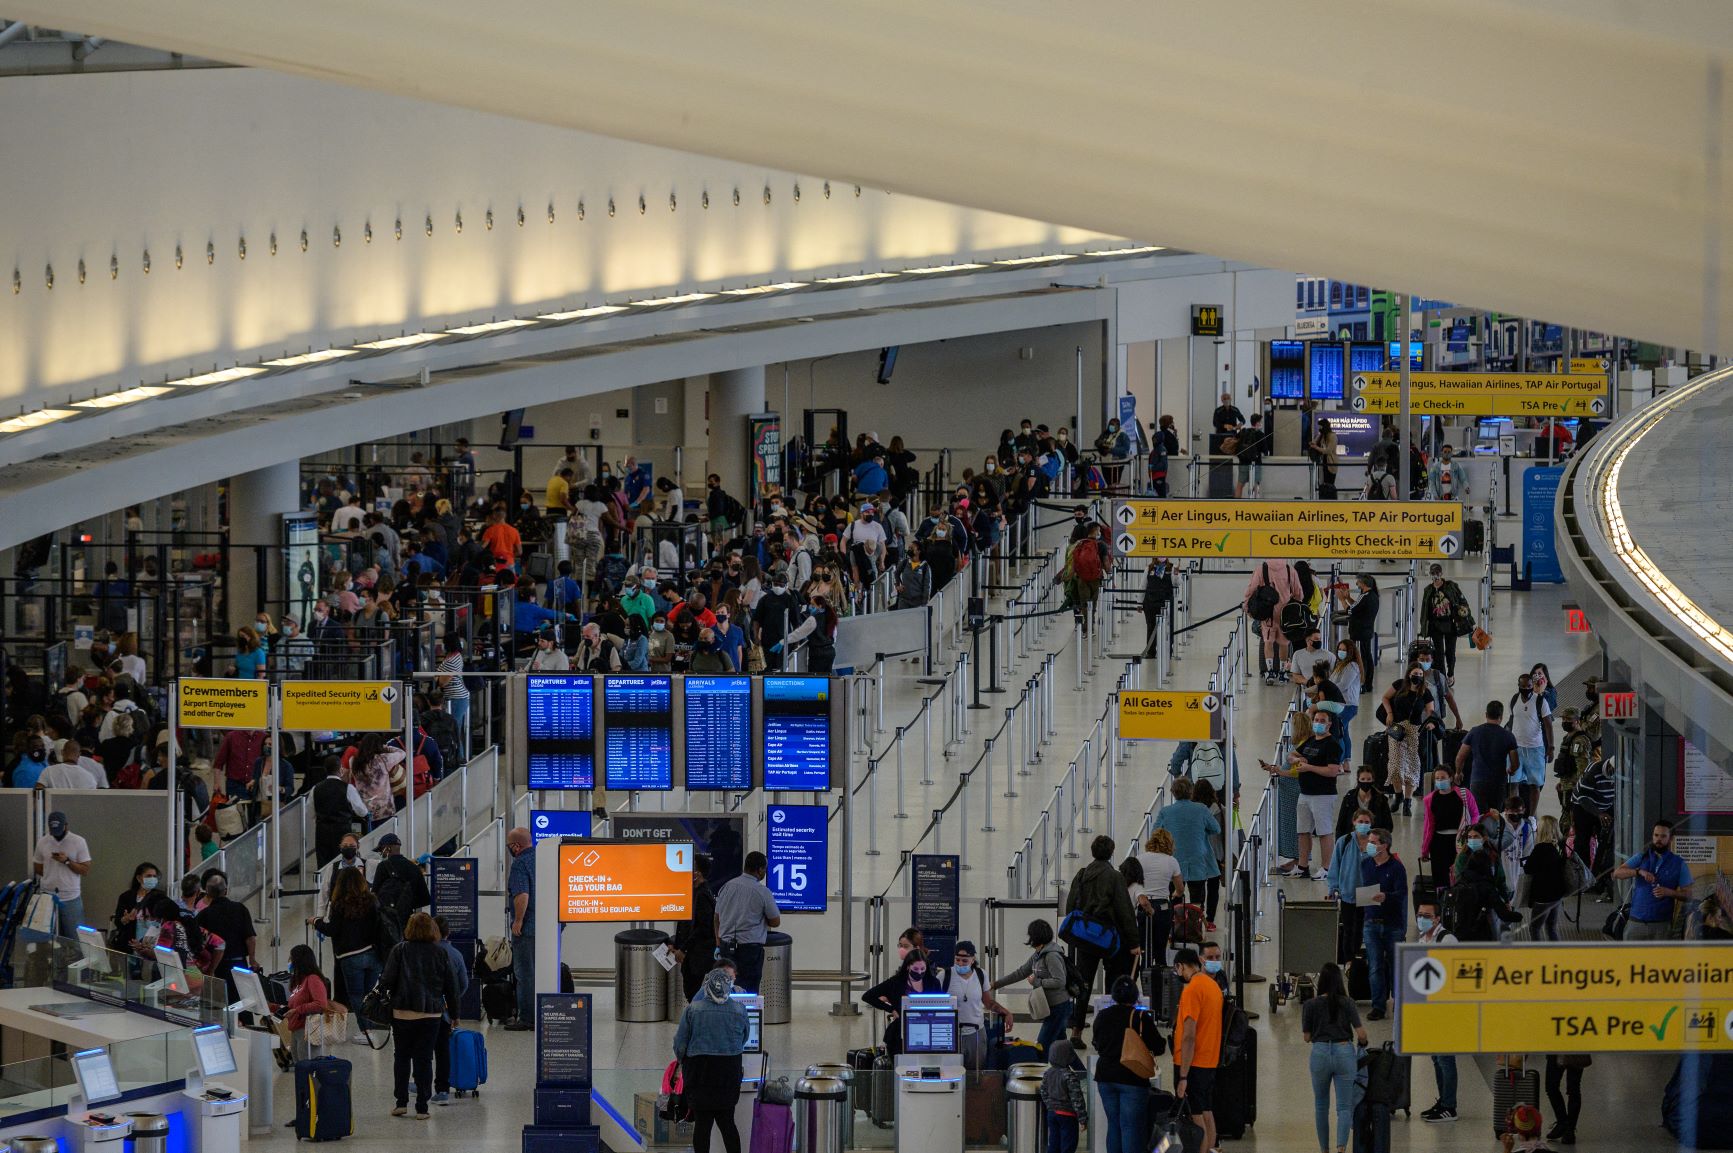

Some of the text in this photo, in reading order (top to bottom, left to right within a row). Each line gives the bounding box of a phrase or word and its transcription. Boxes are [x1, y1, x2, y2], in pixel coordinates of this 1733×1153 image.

[1408, 379, 1436, 389] ingus,
[1439, 379, 1483, 388] Hawaiian
[1485, 380, 1522, 390] Airlines,
[1525, 380, 1543, 389] TAP
[1545, 380, 1559, 389] Air
[1562, 380, 1600, 392] Portugal
[1385, 400, 1464, 409] Jetue Check-in
[1521, 401, 1558, 410] TSA Pre
[1161, 510, 1455, 526] Aer Lingus, Hawaiian Airlines, TAP Air Portugal
[1162, 538, 1212, 549] TSA Pre
[1270, 535, 1411, 549] Cuba Flights Check-in
[183, 686, 258, 697] Crewmembers
[286, 690, 360, 699] Expedited Security
[1124, 698, 1172, 707] All Gates
[1604, 693, 1633, 717] EXIT
[623, 829, 672, 838] DON'T GET
[676, 850, 683, 864] 1
[773, 864, 807, 890] 15
[660, 904, 685, 912] jetBlue
[1493, 964, 1733, 990] Aer Lingus, Hawaiian
[1552, 1017, 1644, 1036] TSA Pre
